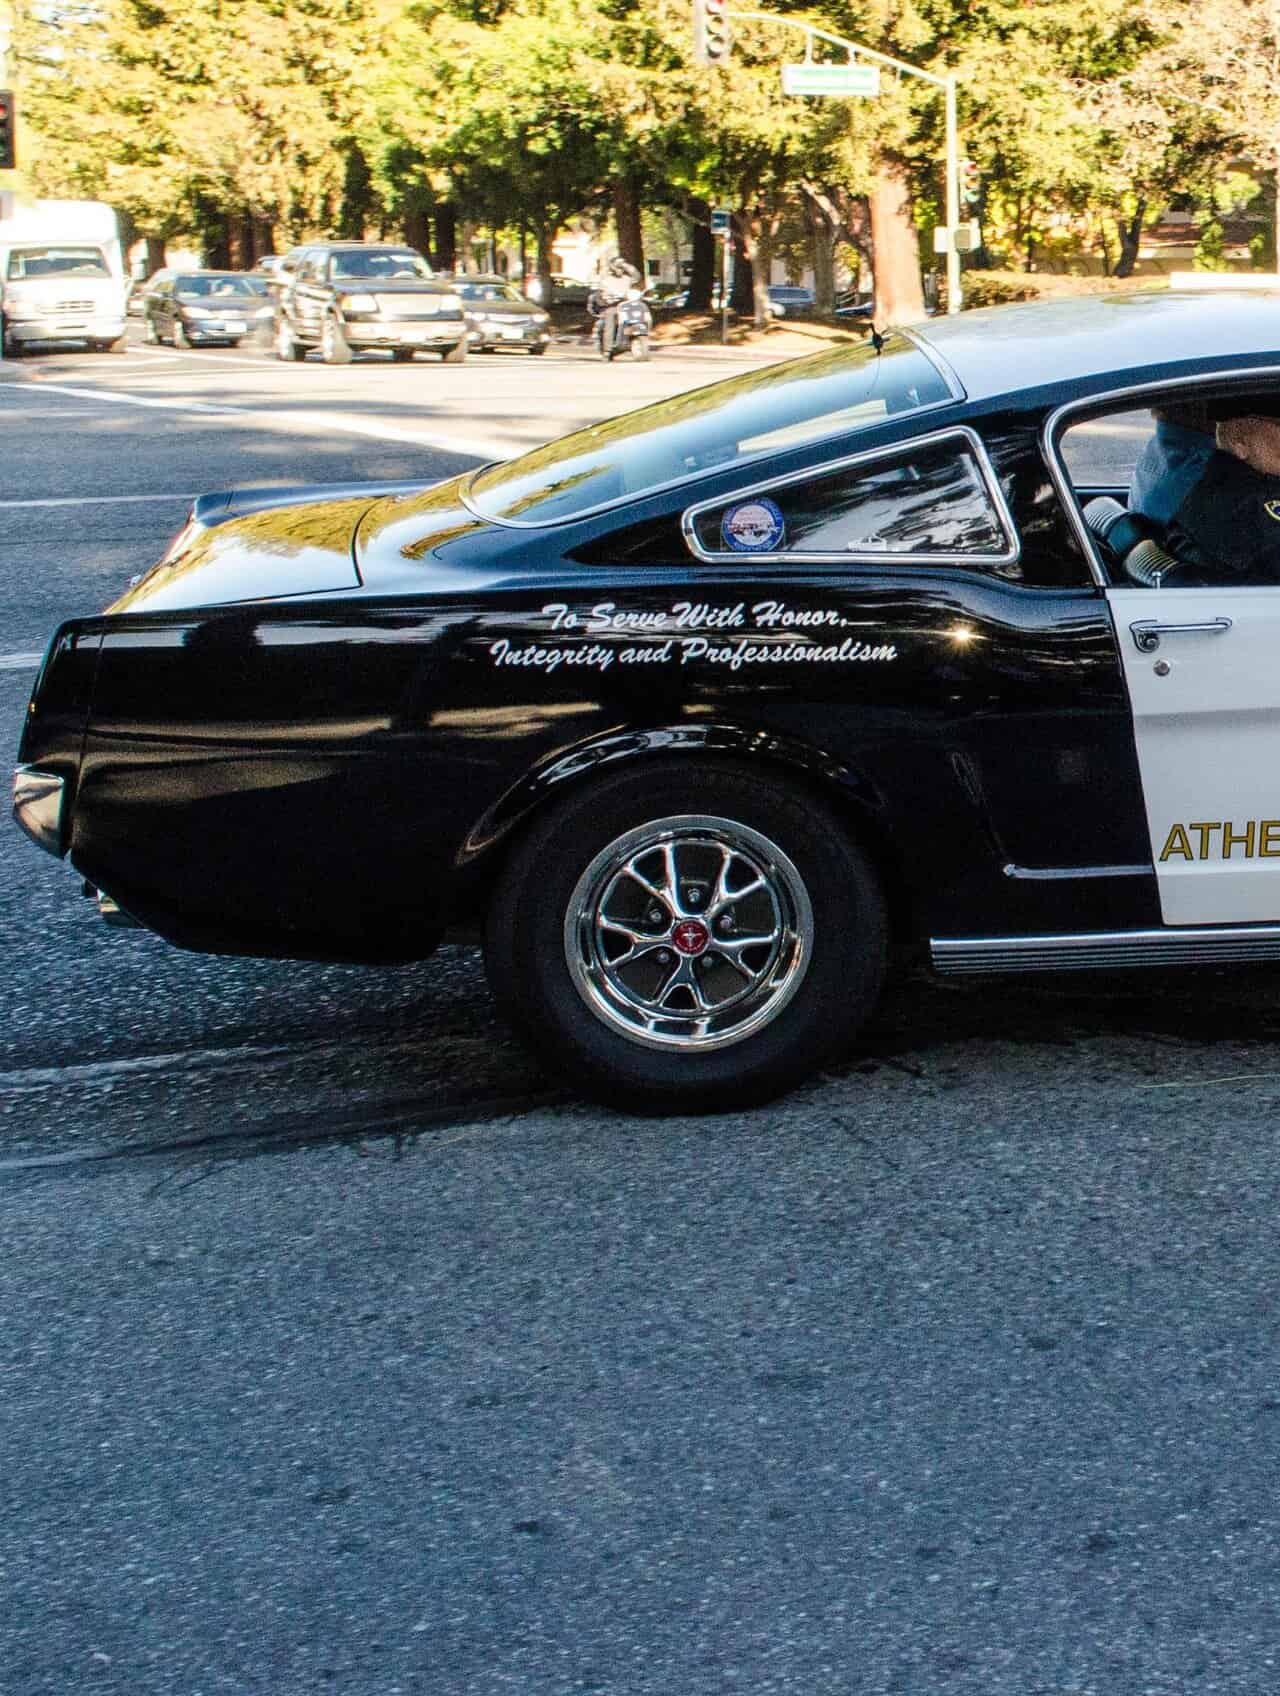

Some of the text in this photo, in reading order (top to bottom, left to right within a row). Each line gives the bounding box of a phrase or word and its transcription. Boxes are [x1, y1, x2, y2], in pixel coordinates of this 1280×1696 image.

[541, 603, 578, 630] To
[588, 602, 667, 632] Serve
[671, 602, 744, 629] With
[489, 637, 898, 673] Integrity and Professionalism
